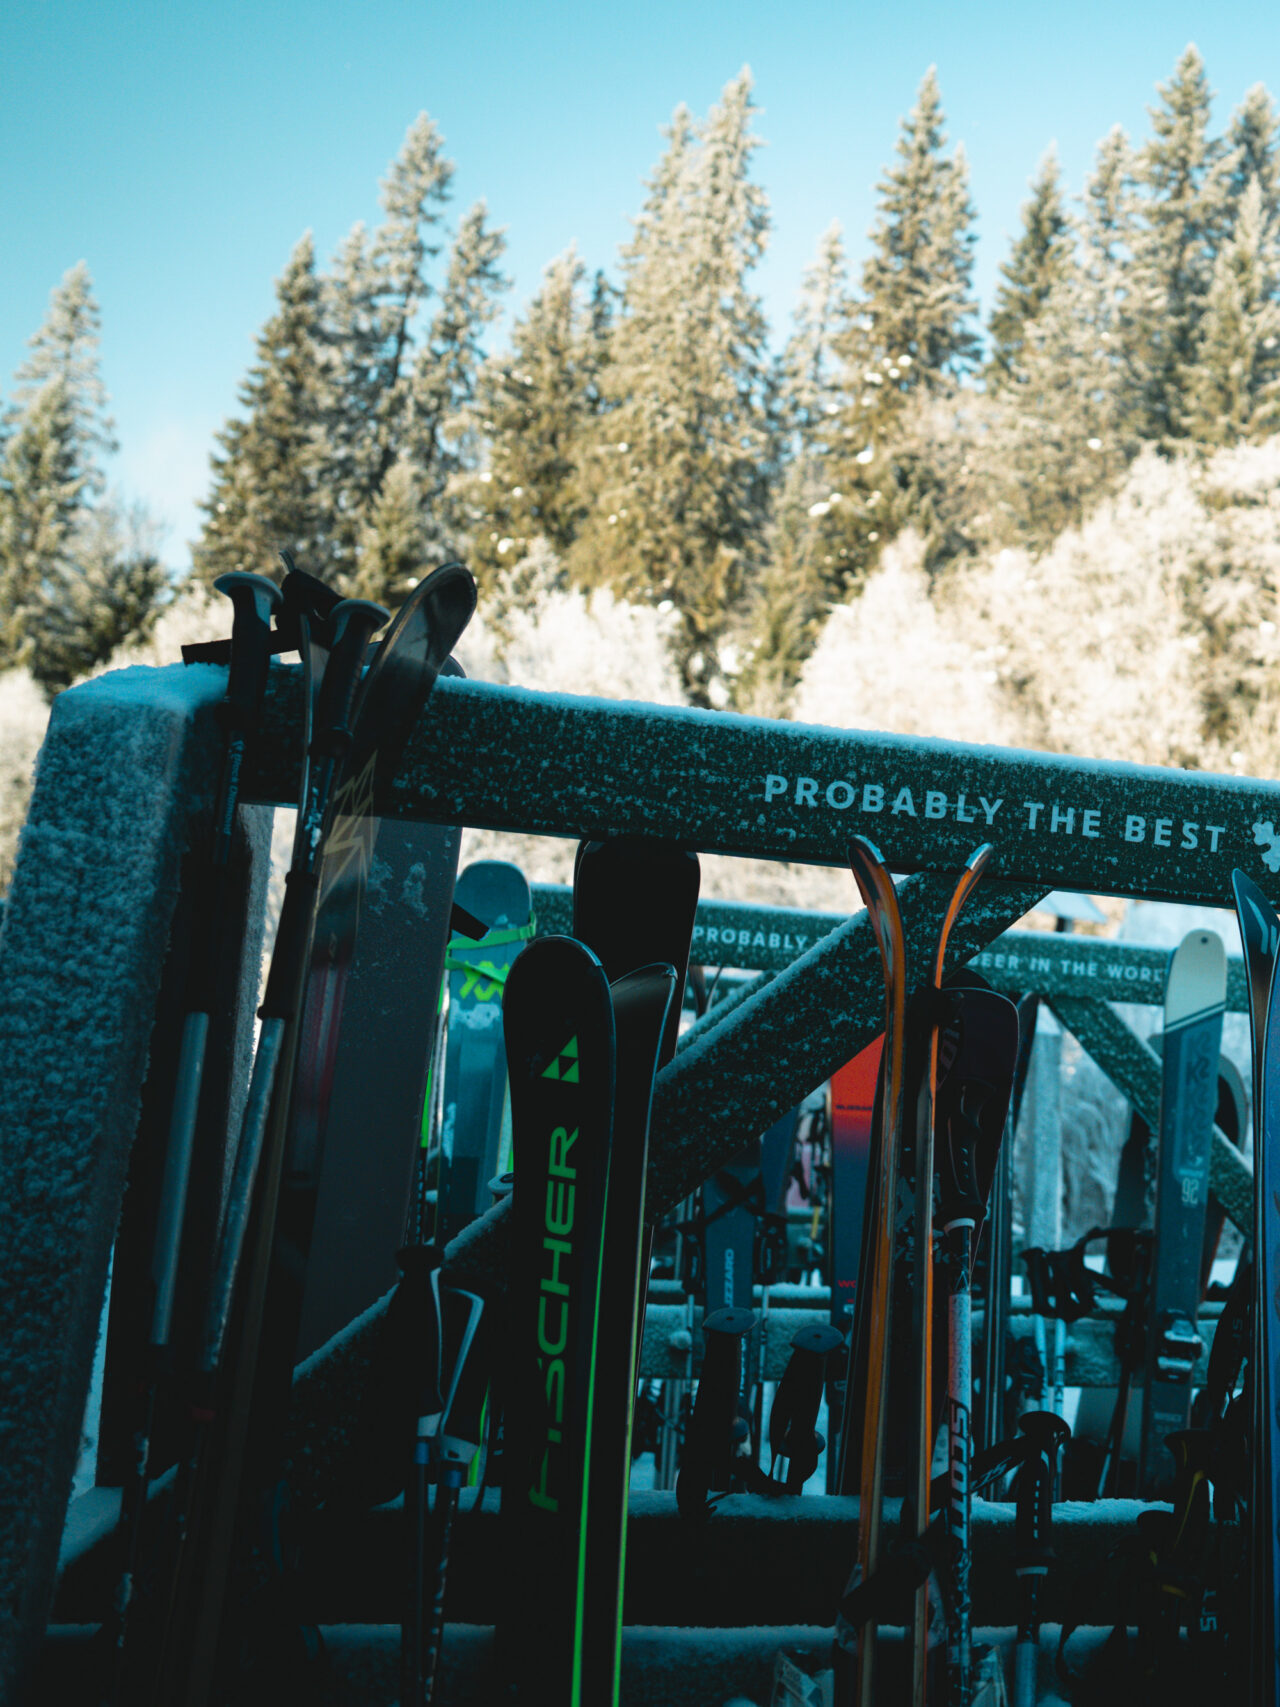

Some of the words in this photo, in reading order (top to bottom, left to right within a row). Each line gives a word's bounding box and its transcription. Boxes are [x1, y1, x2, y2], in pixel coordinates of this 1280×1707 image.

[764, 774, 1003, 826] PROBABLY
[1023, 801, 1101, 838] THE
[1124, 815, 1226, 853] BEST
[692, 925, 808, 950] PROBABLY
[967, 951, 1019, 970] BEER
[1029, 957, 1051, 972] IN
[1060, 959, 1098, 977] THE
[1107, 963, 1162, 984] WORL
[1181, 1176, 1200, 1206] 92
[528, 1125, 580, 1513] FISCHER
[950, 1402, 969, 1550] SCOTT
